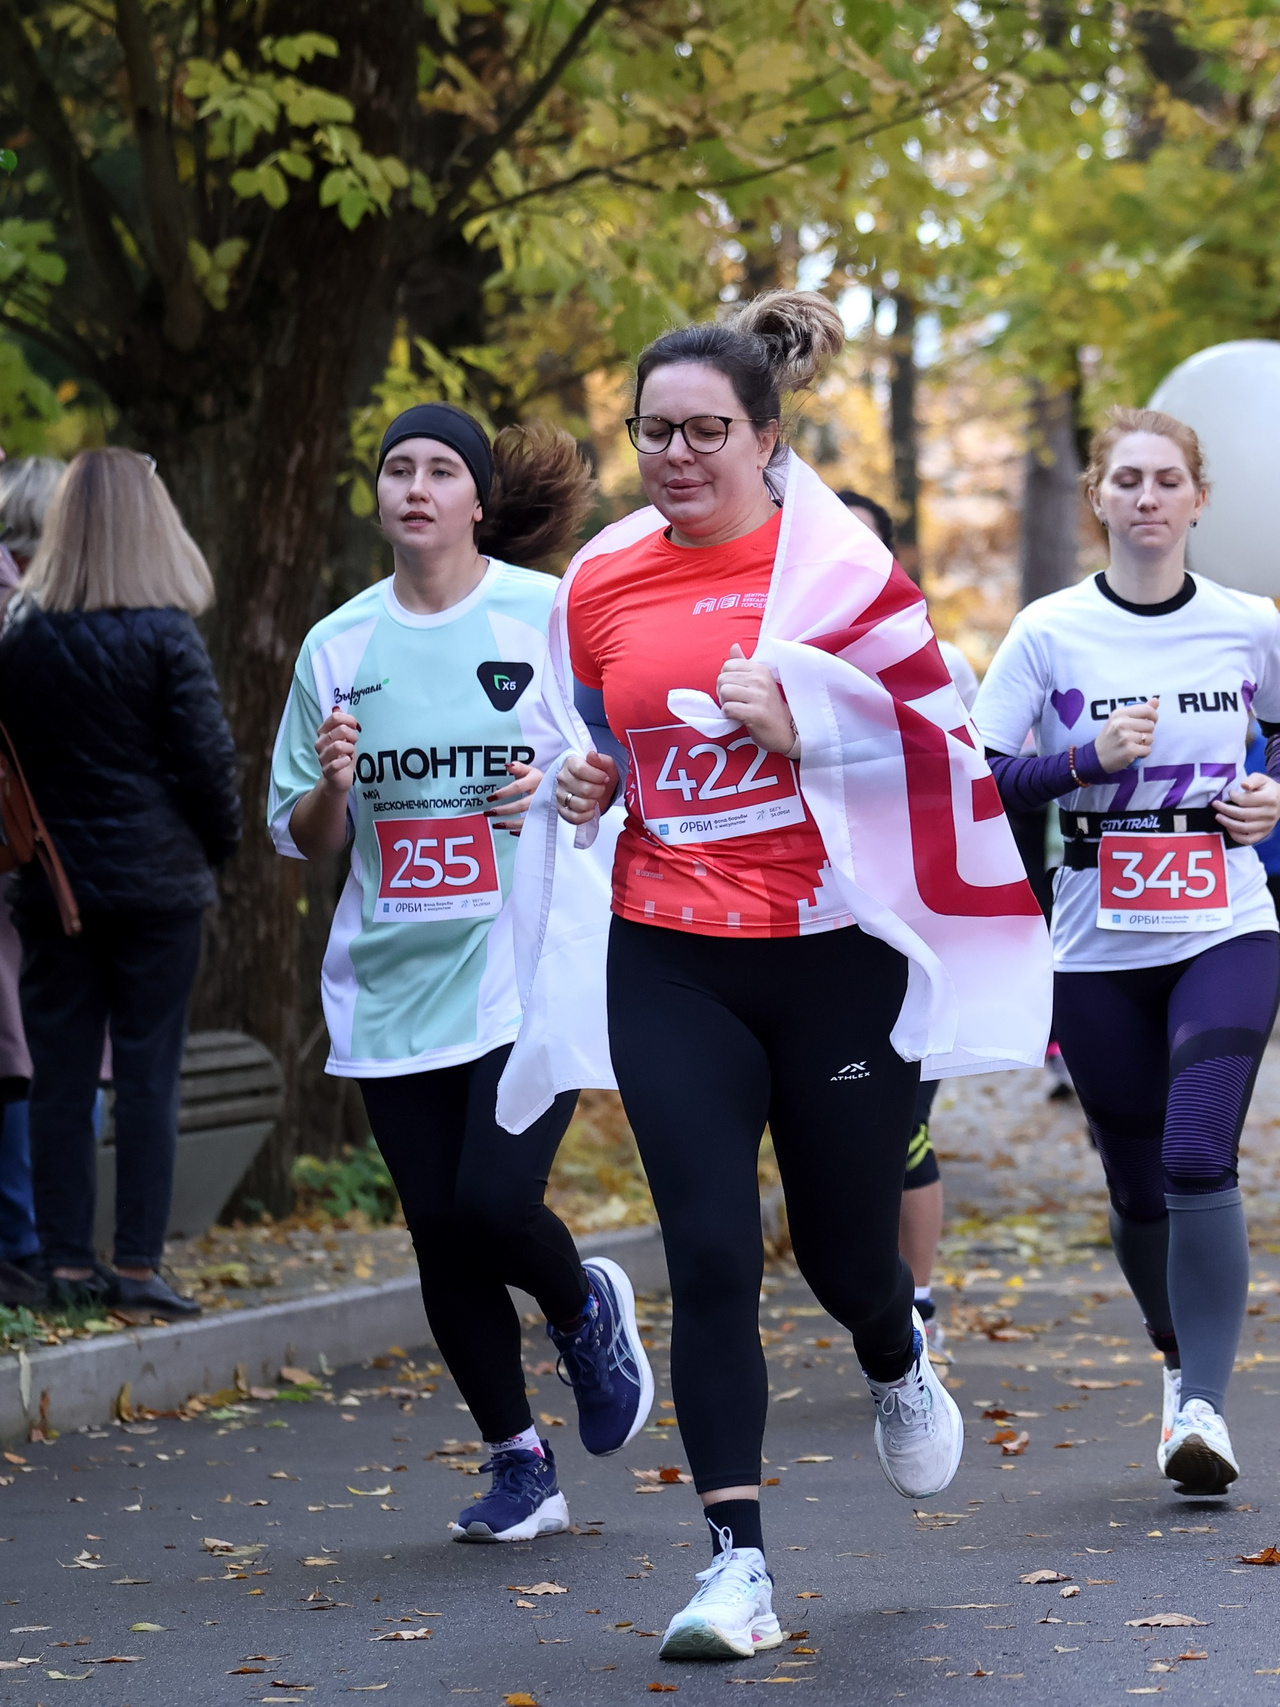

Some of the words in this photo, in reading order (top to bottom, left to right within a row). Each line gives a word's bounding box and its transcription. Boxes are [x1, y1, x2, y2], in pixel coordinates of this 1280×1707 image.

[502, 681, 517, 691] X5
[1178, 692, 1238, 714] RUN
[353, 745, 536, 786] ОЛОНТЕР
[655, 736, 779, 802] 422
[362, 789, 381, 800] МОЙ
[373, 800, 428, 812] БЕСКОНЕЧНО
[429, 798, 484, 809] ПОМОГАТЬ
[679, 820, 713, 834] ОРБИ
[389, 835, 480, 889] 255
[1111, 850, 1217, 899] 345
[395, 902, 422, 913] ОРБИ
[1129, 914, 1160, 924] ОРБИ
[830, 1071, 871, 1082] ATHLEX
